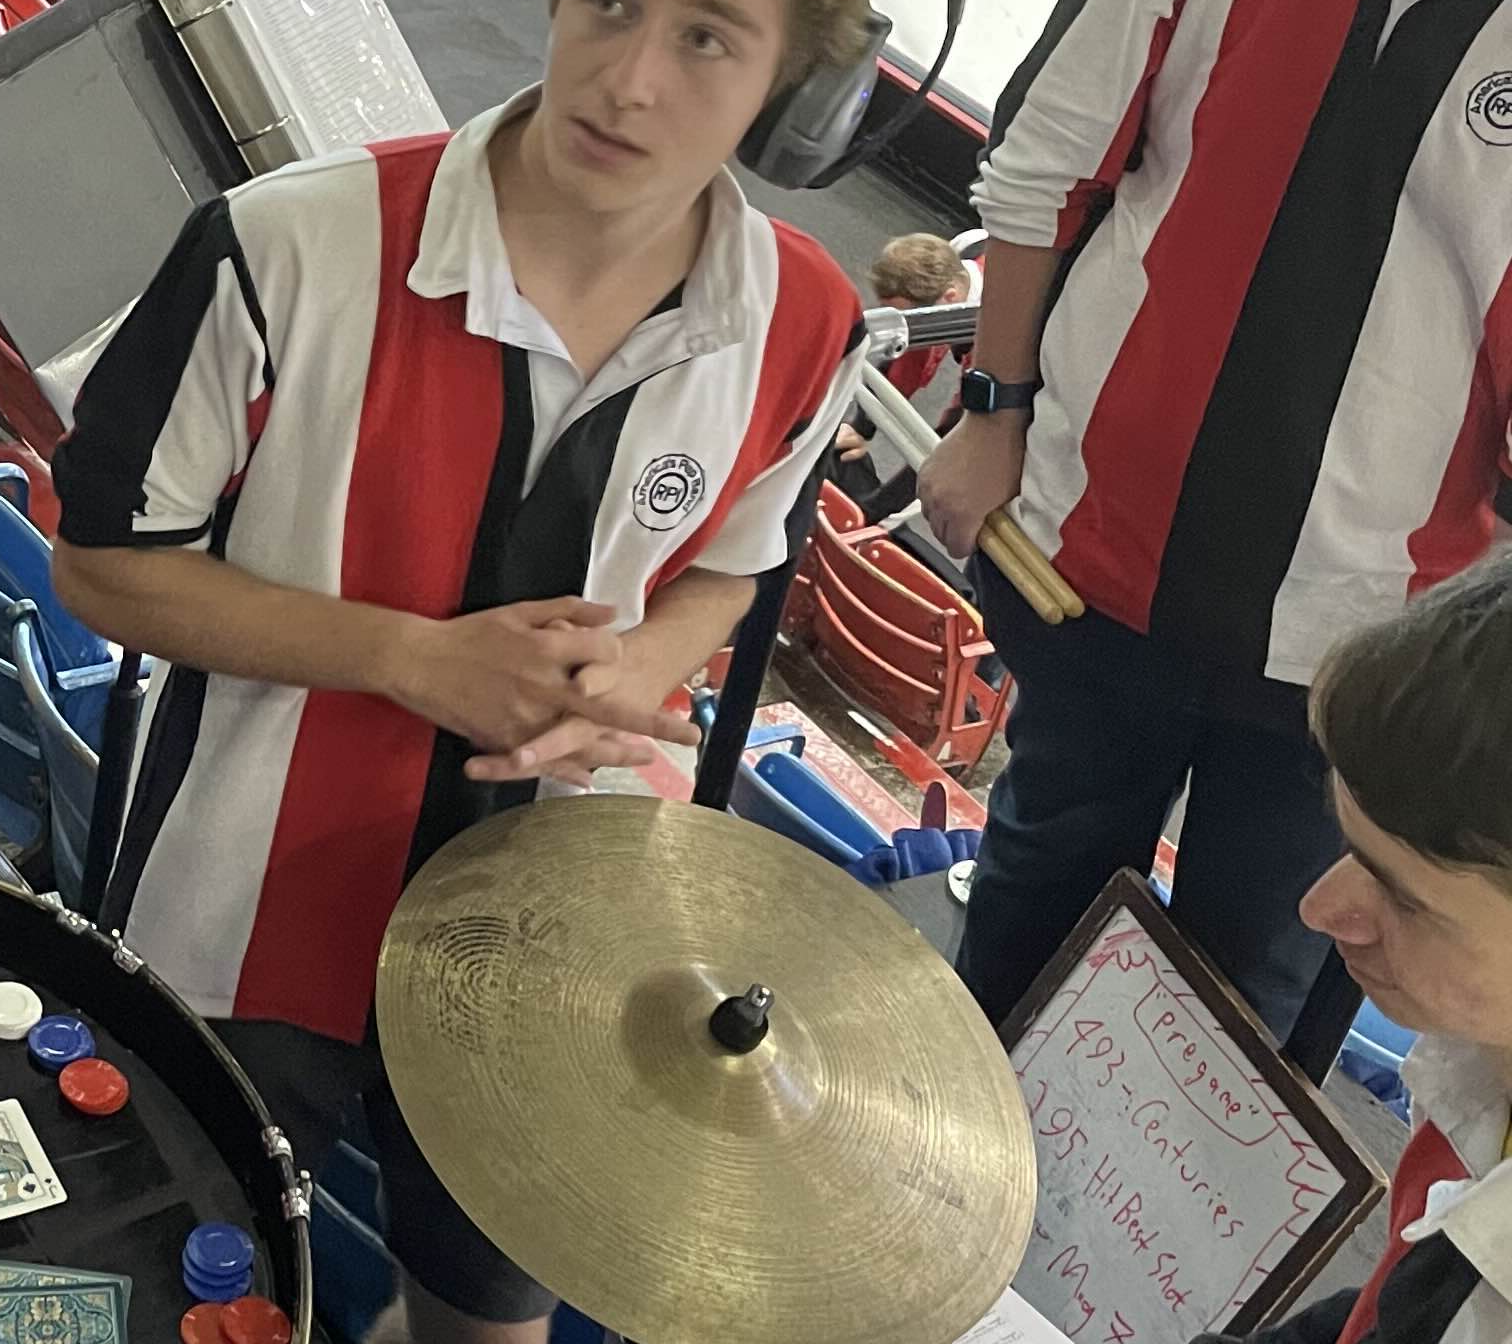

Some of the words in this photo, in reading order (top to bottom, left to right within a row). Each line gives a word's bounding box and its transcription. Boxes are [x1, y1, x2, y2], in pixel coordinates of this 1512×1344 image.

[652, 482, 684, 504] RPI
[1066, 1020, 1125, 1088] 493
[1130, 1099, 1244, 1238] Centuries
[1112, 1191, 1160, 1256] Best
[1147, 1252, 1193, 1313] Shot
